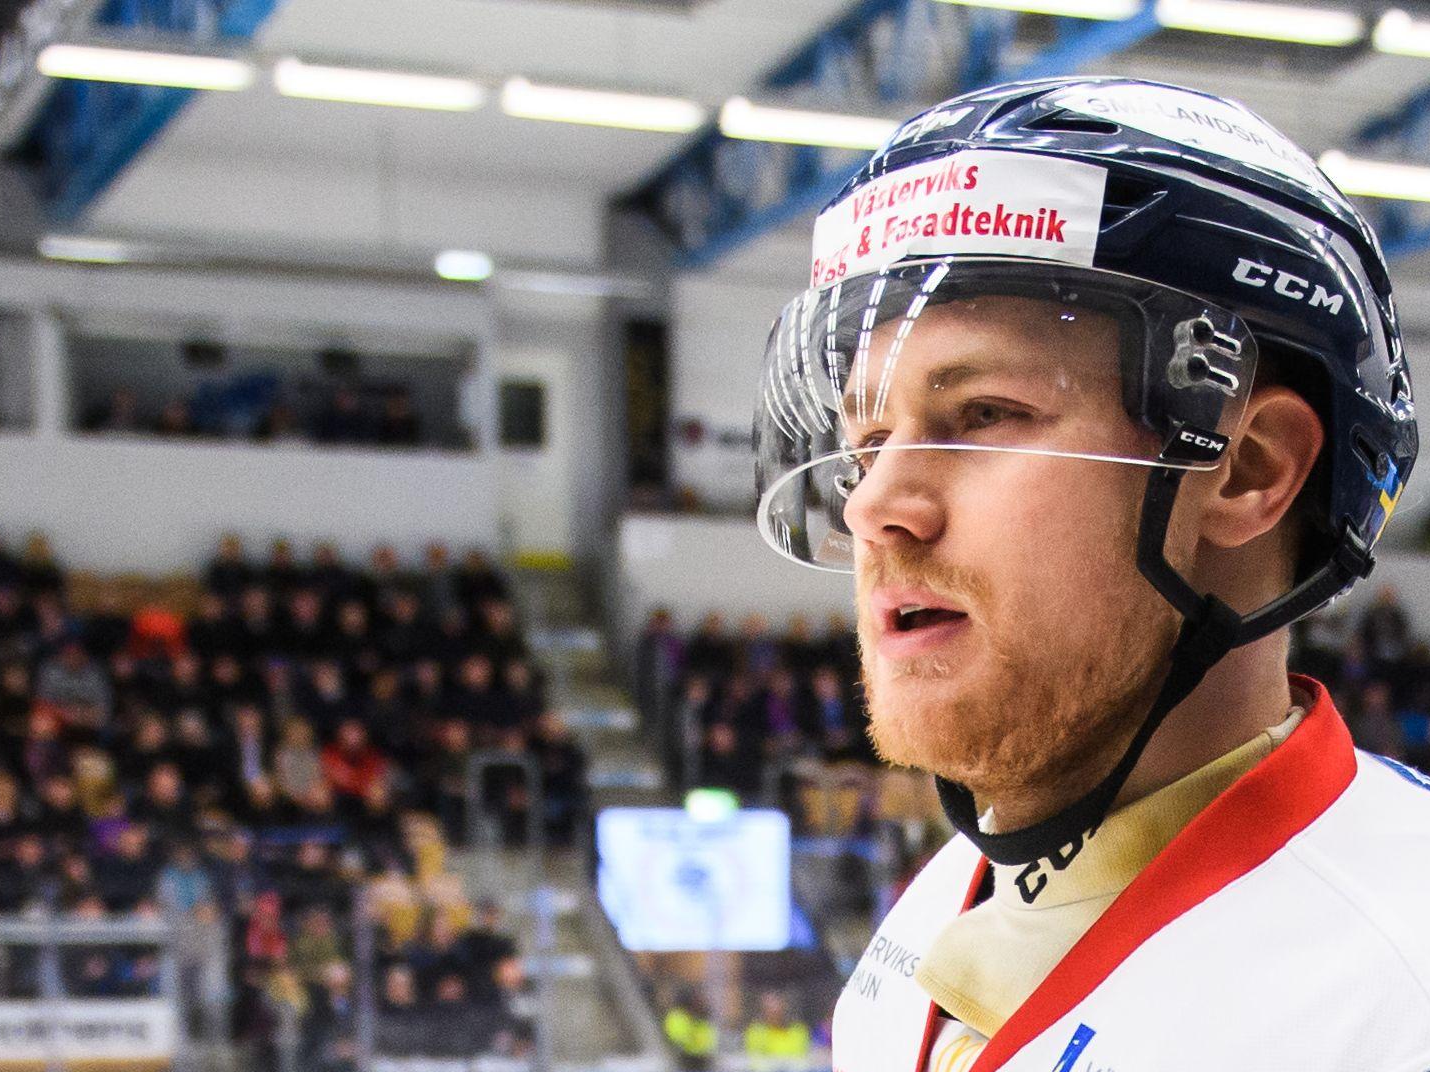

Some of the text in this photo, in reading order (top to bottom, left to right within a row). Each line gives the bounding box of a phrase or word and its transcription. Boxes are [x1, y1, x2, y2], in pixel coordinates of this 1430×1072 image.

[853, 162, 979, 224] Västerviks
[857, 225, 872, 258] &
[882, 203, 1068, 249] Fasadteknik
[1231, 257, 1344, 316] CCM
[1179, 430, 1224, 452] CCM
